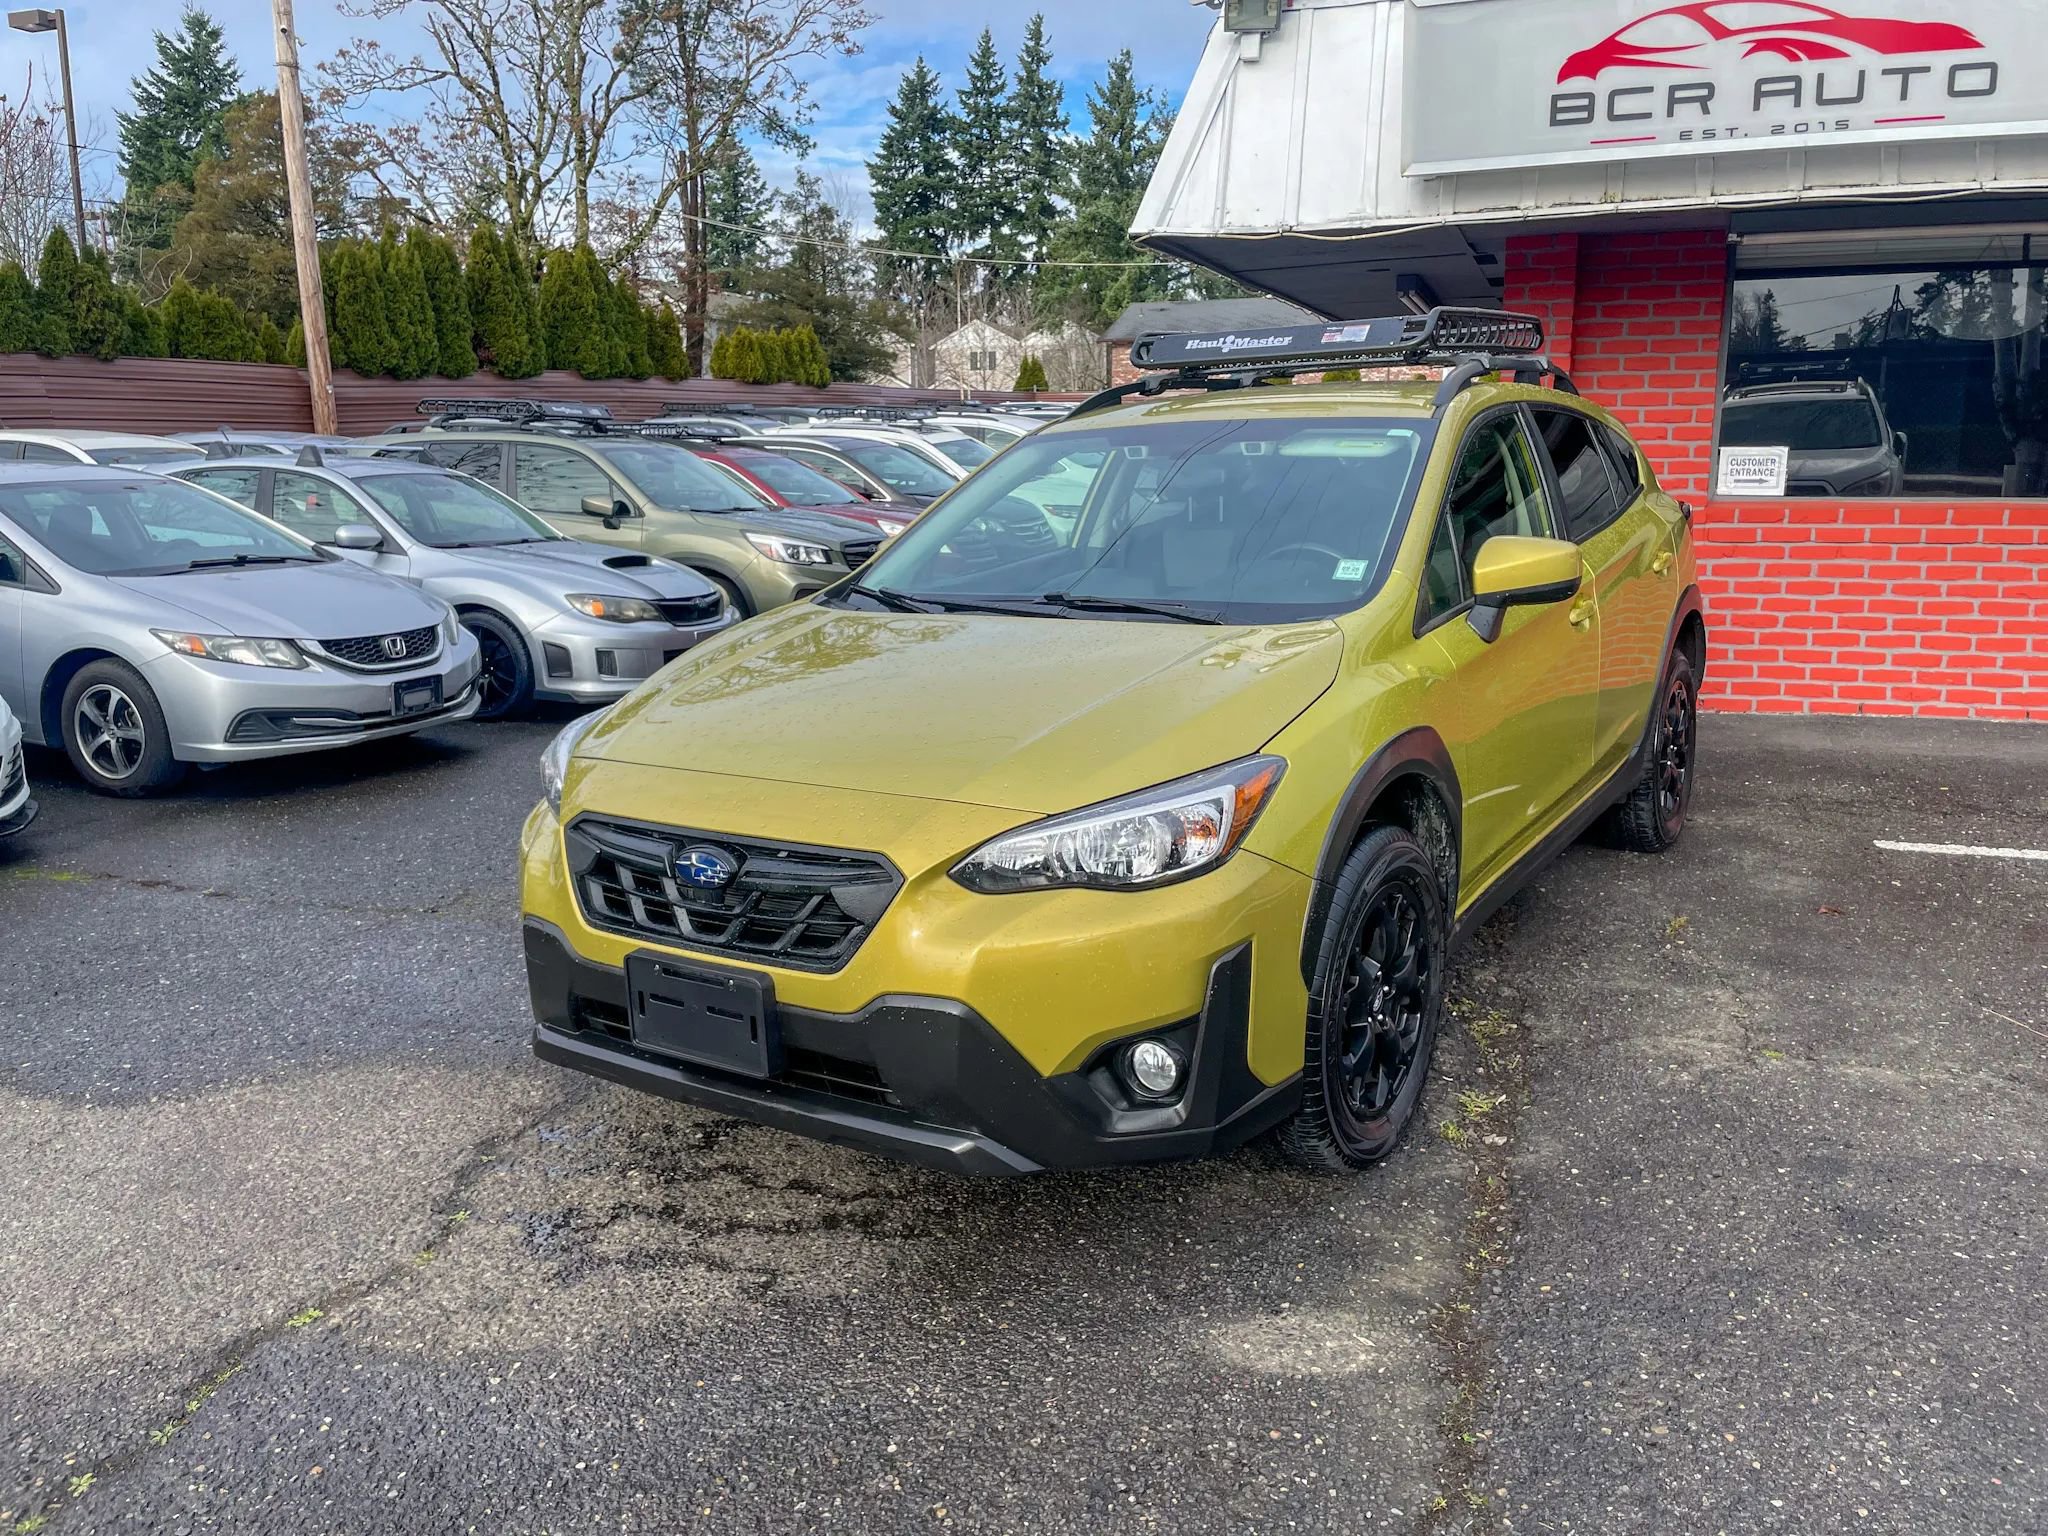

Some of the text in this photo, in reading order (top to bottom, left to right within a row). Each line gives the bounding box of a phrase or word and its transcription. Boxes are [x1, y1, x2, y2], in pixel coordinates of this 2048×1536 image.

[1549, 61, 1999, 127] BCR AUTO
[1679, 119, 1851, 141] EST. 2015
[1233, 335, 1293, 350] Master
[1730, 458, 1776, 467] CUSTOMER
[1729, 468, 1775, 477] ENTRANCE
